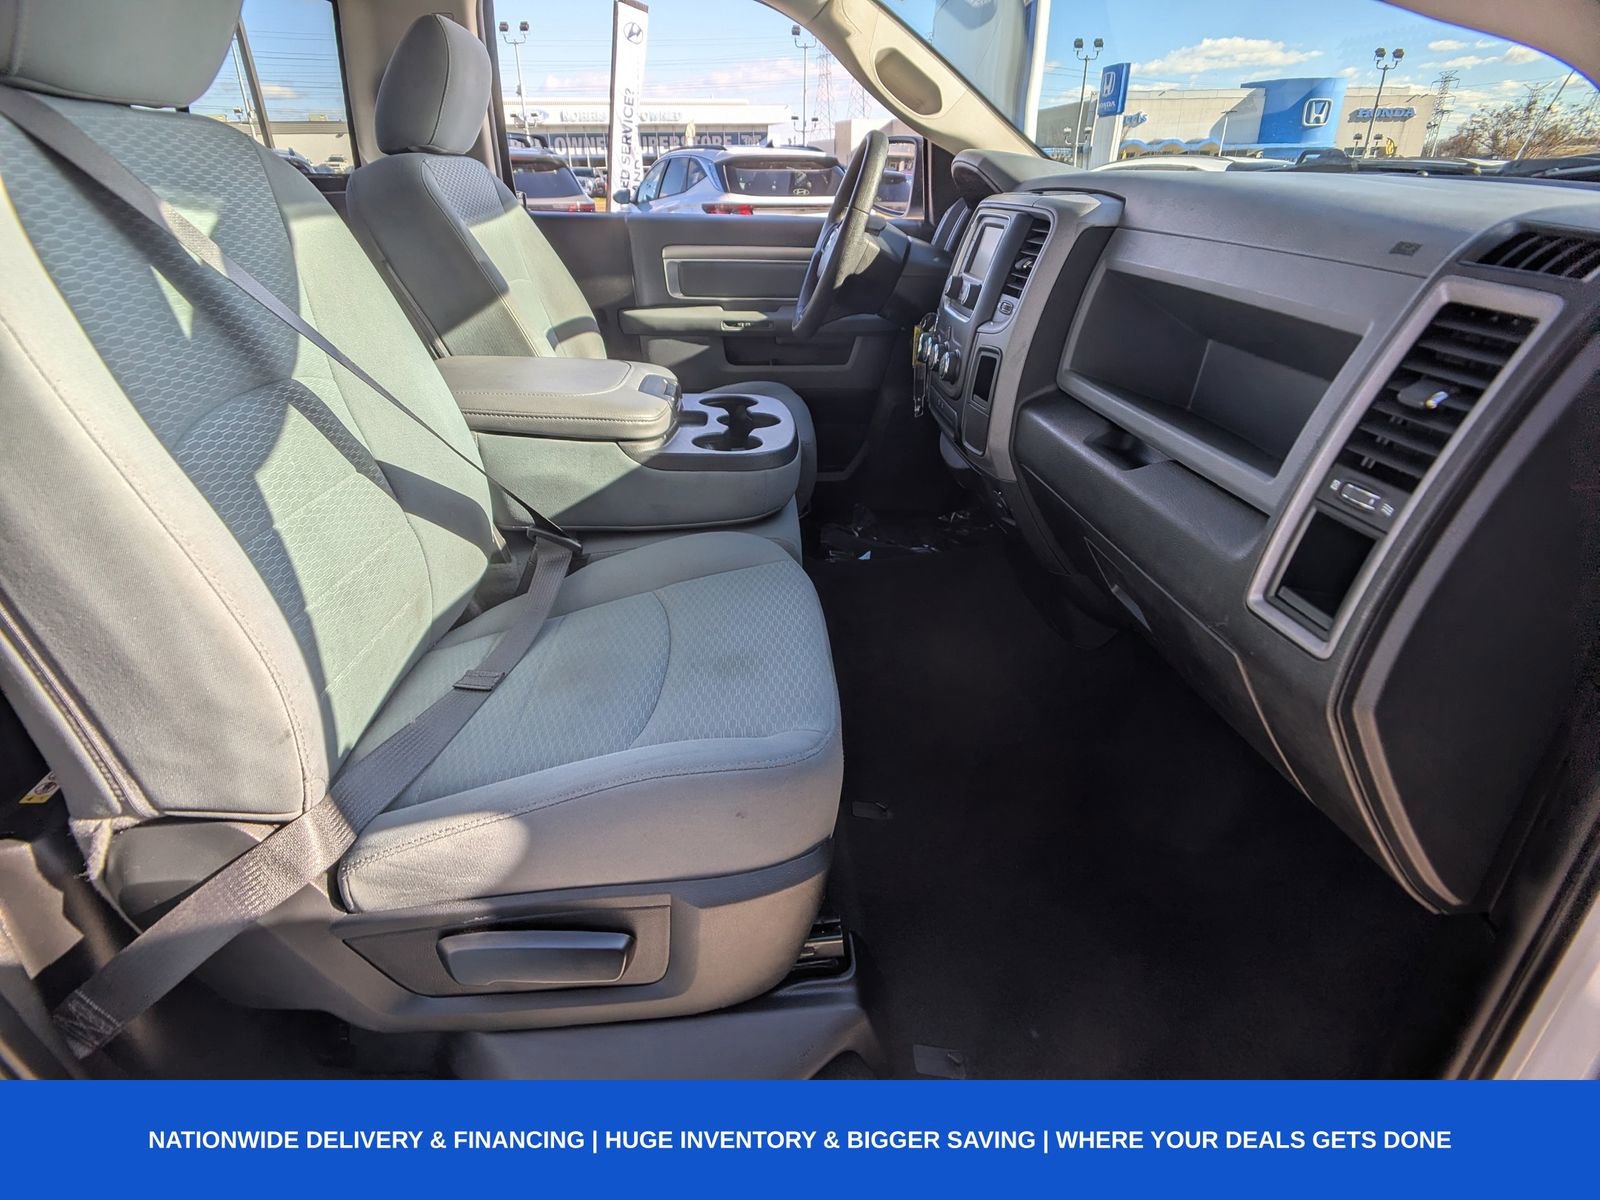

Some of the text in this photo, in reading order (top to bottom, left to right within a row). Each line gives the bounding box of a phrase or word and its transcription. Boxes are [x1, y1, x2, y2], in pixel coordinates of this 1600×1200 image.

[1356, 107, 1415, 118] HONDA
[621, 87, 635, 165] SERVICE?
[554, 137, 608, 155] OWNE
[639, 134, 732, 153] UPERTORE
